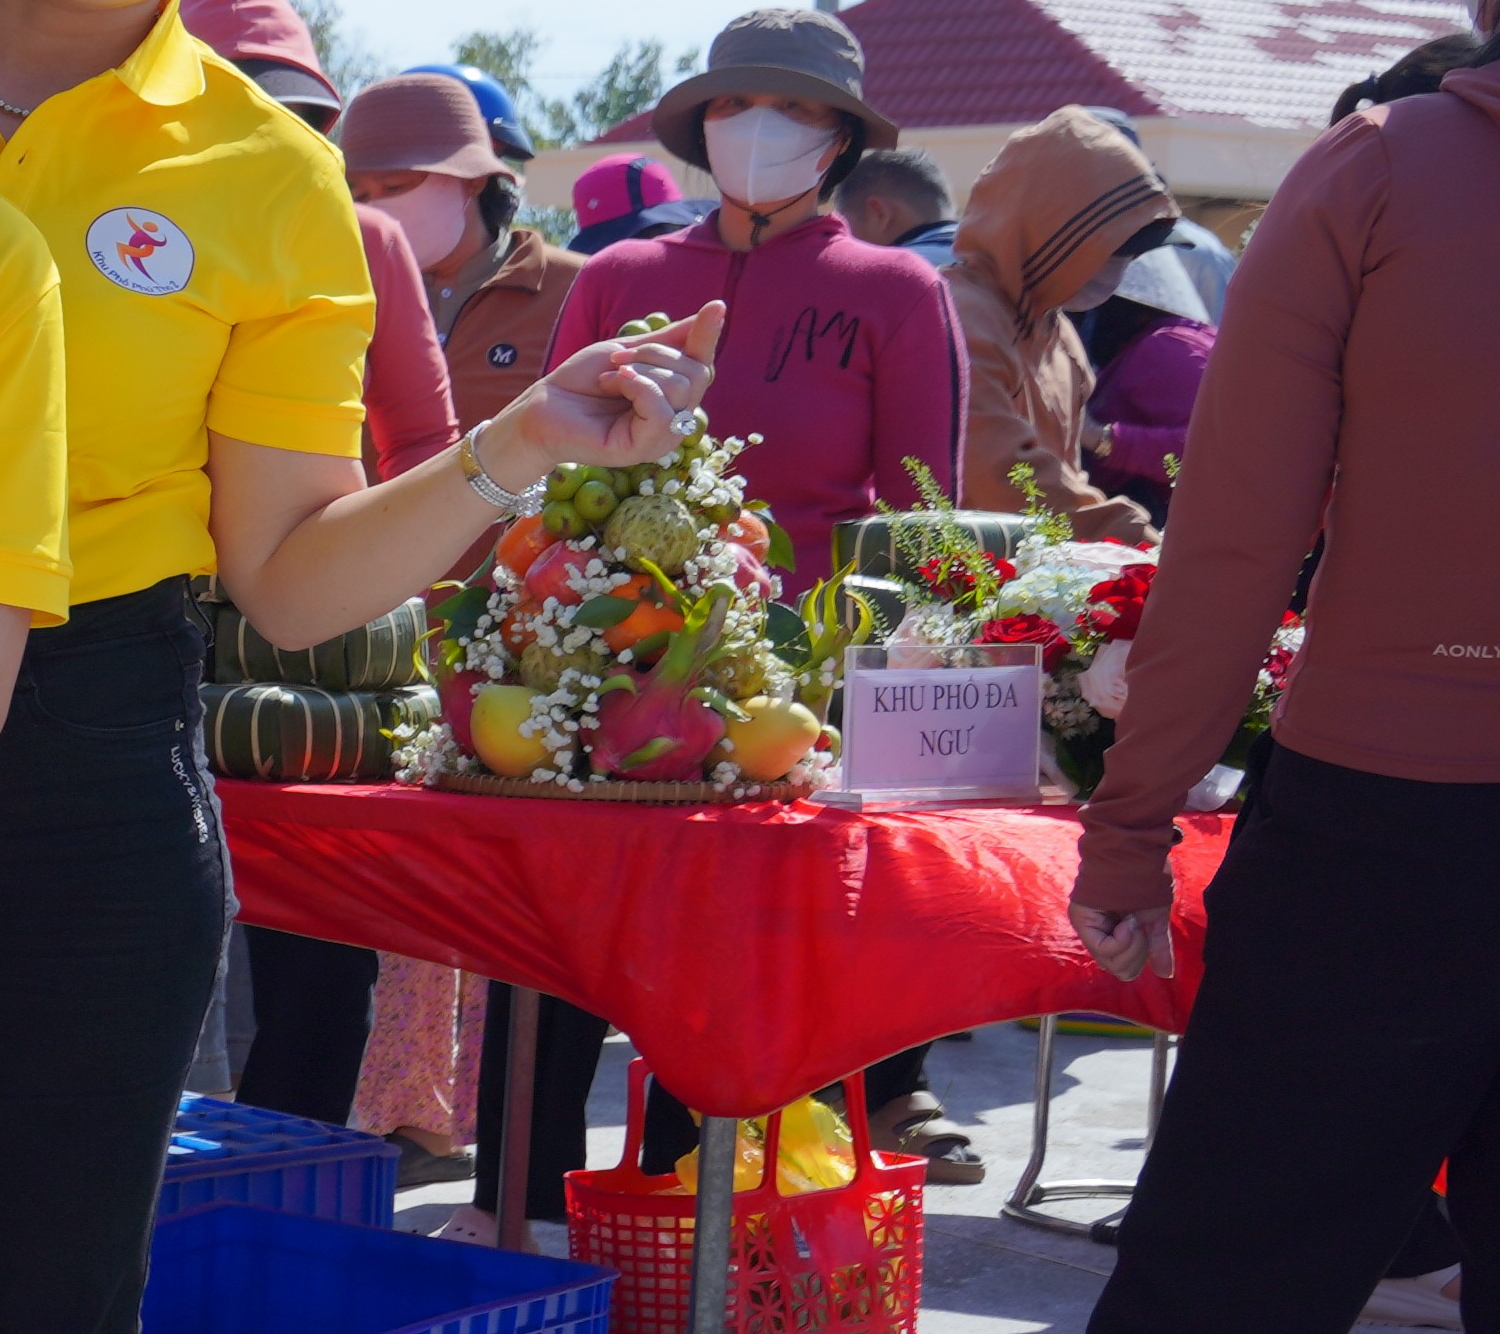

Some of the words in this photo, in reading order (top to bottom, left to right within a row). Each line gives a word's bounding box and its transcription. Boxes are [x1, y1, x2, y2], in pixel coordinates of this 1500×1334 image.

[873, 685, 927, 713] KHU
[933, 676, 980, 710] PHỐ
[985, 683, 1018, 709] ĐA
[919, 724, 975, 757] NGƯ
